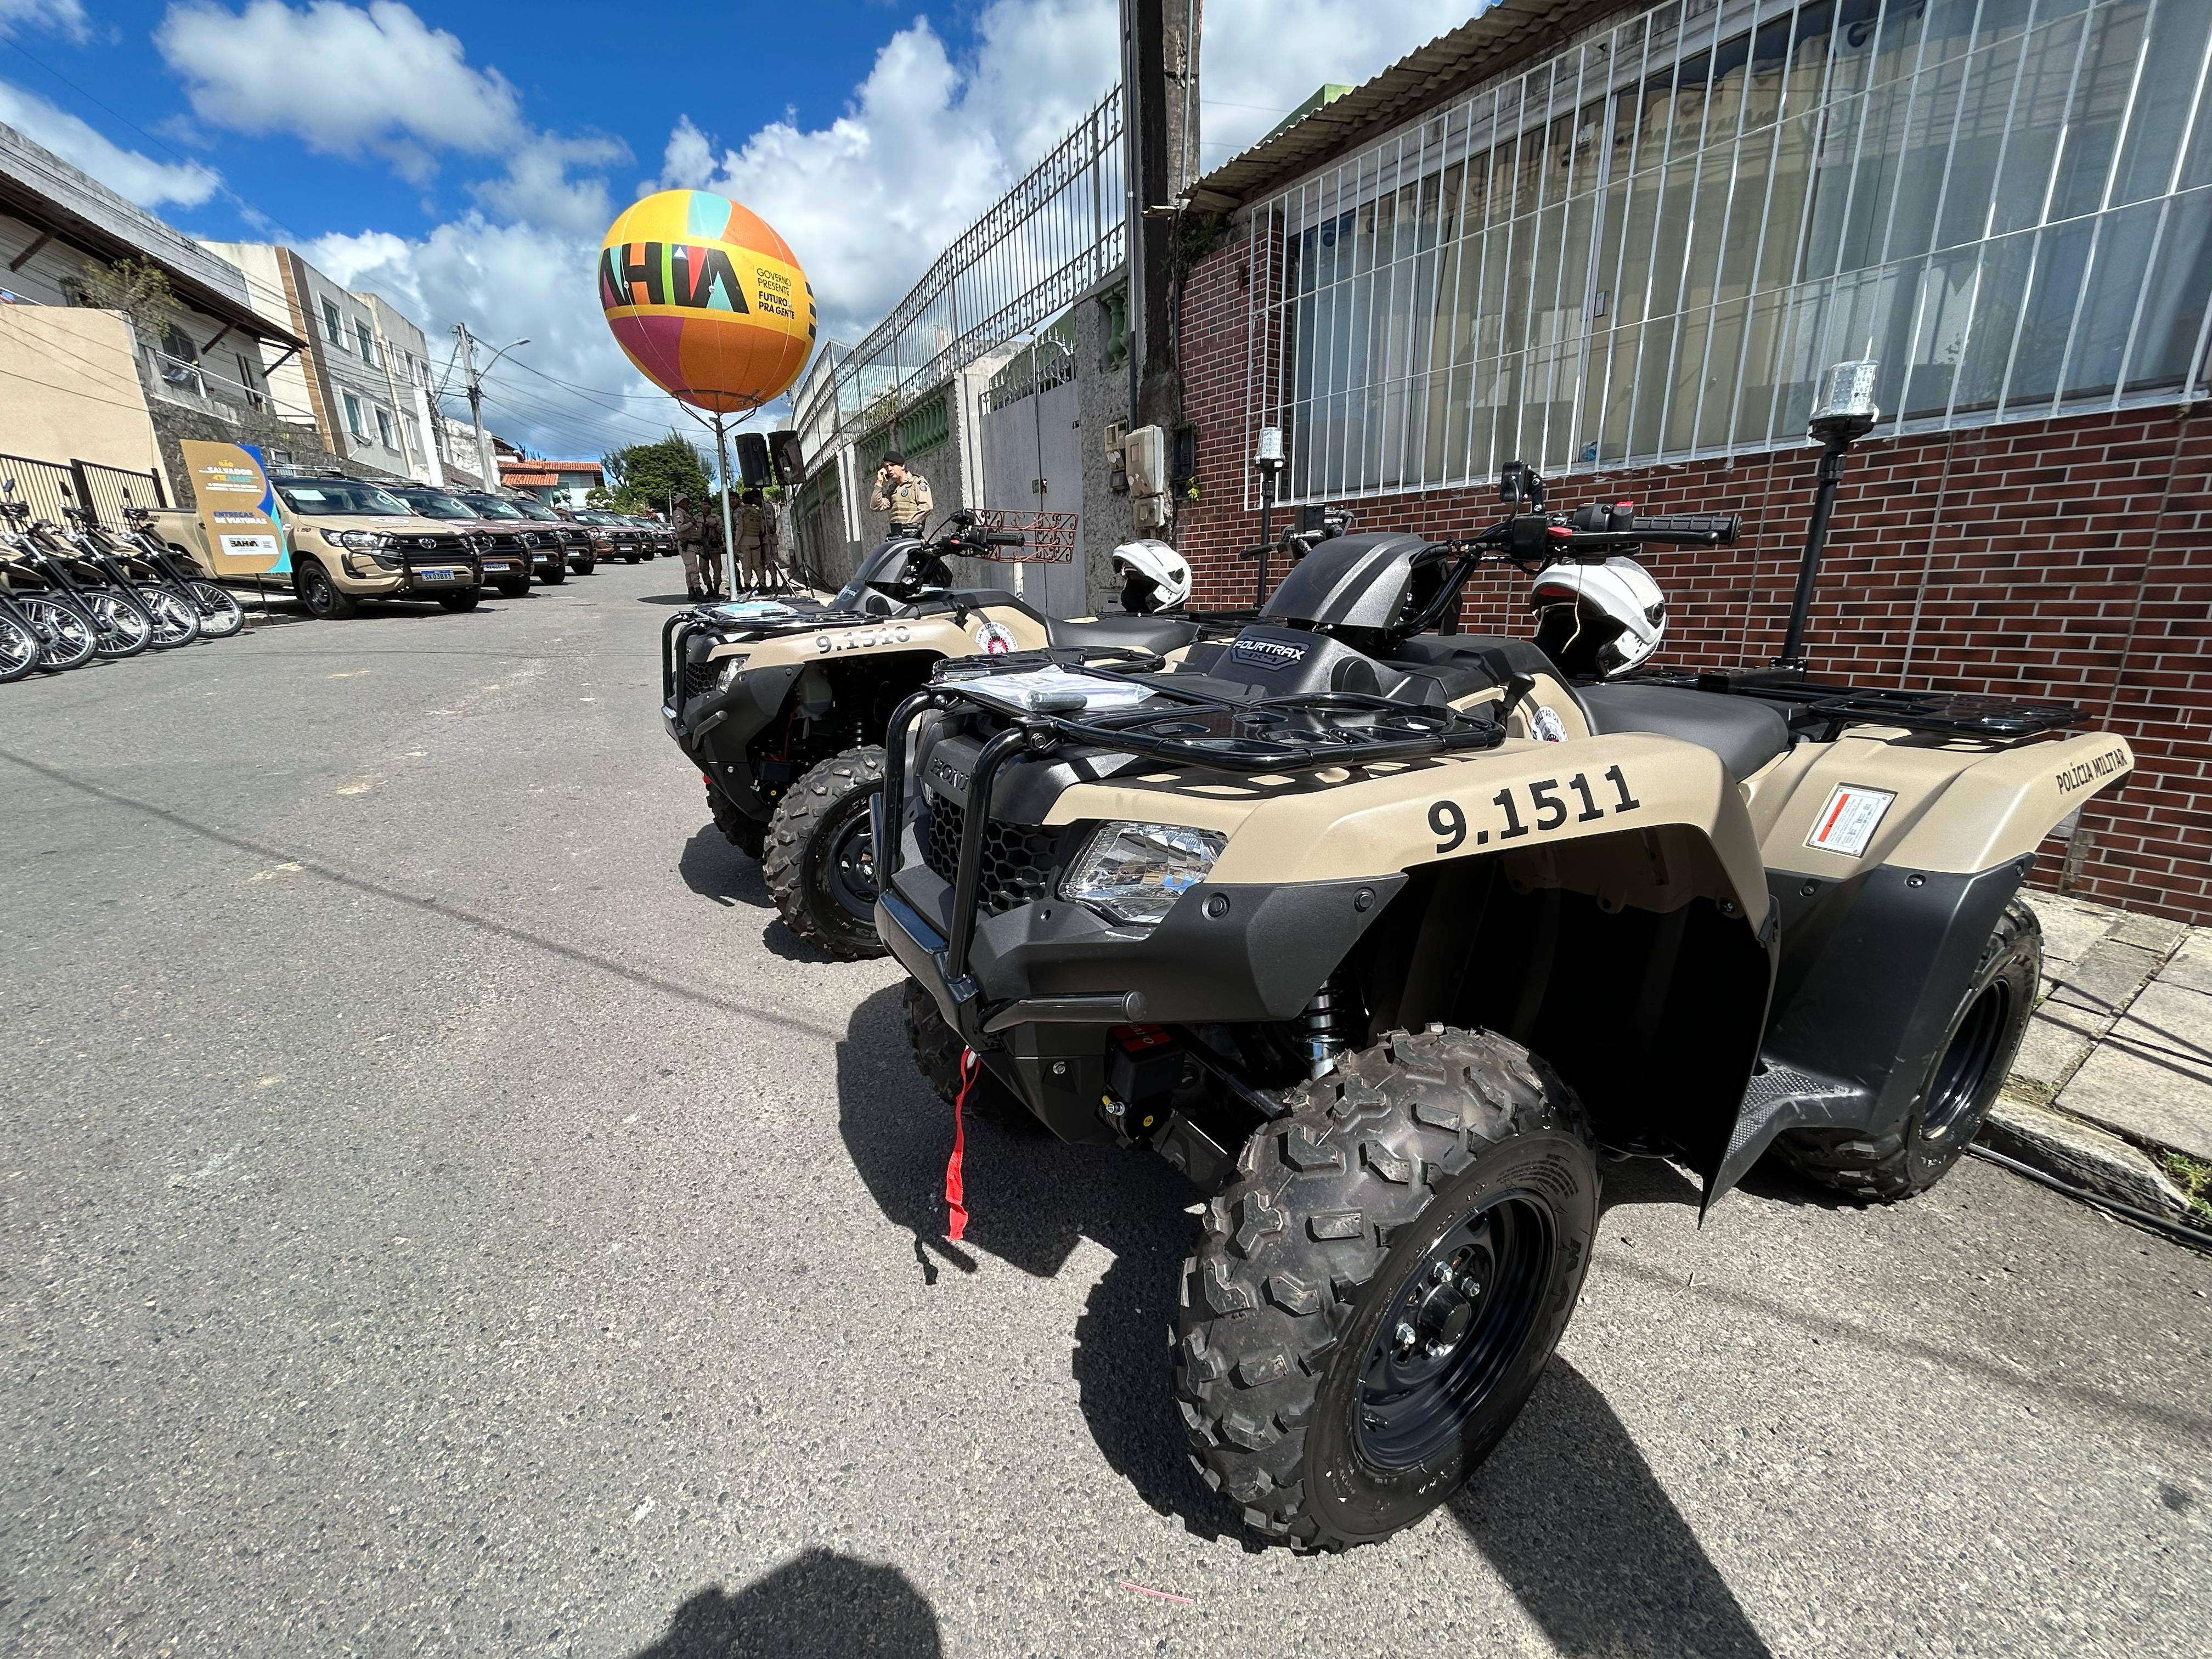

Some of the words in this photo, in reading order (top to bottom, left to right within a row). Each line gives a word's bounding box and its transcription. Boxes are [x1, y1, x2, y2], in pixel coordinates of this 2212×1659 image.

[599, 241, 751, 314] AHIA
[757, 268, 791, 286] GOVERNO
[758, 278, 789, 296] PRESENTE
[759, 291, 788, 307] FUTURO
[759, 301, 775, 313] PRA
[775, 306, 795, 320] GENTE
[207, 466, 253, 476] SALVADOR
[816, 626, 911, 654] 9.1510
[1233, 640, 1306, 661] FOURTRAX
[929, 757, 971, 794] HON
[2056, 761, 2095, 795] POLÍCIA
[2091, 748, 2128, 778] MILITAR
[1427, 764, 1640, 854] 9.1511
